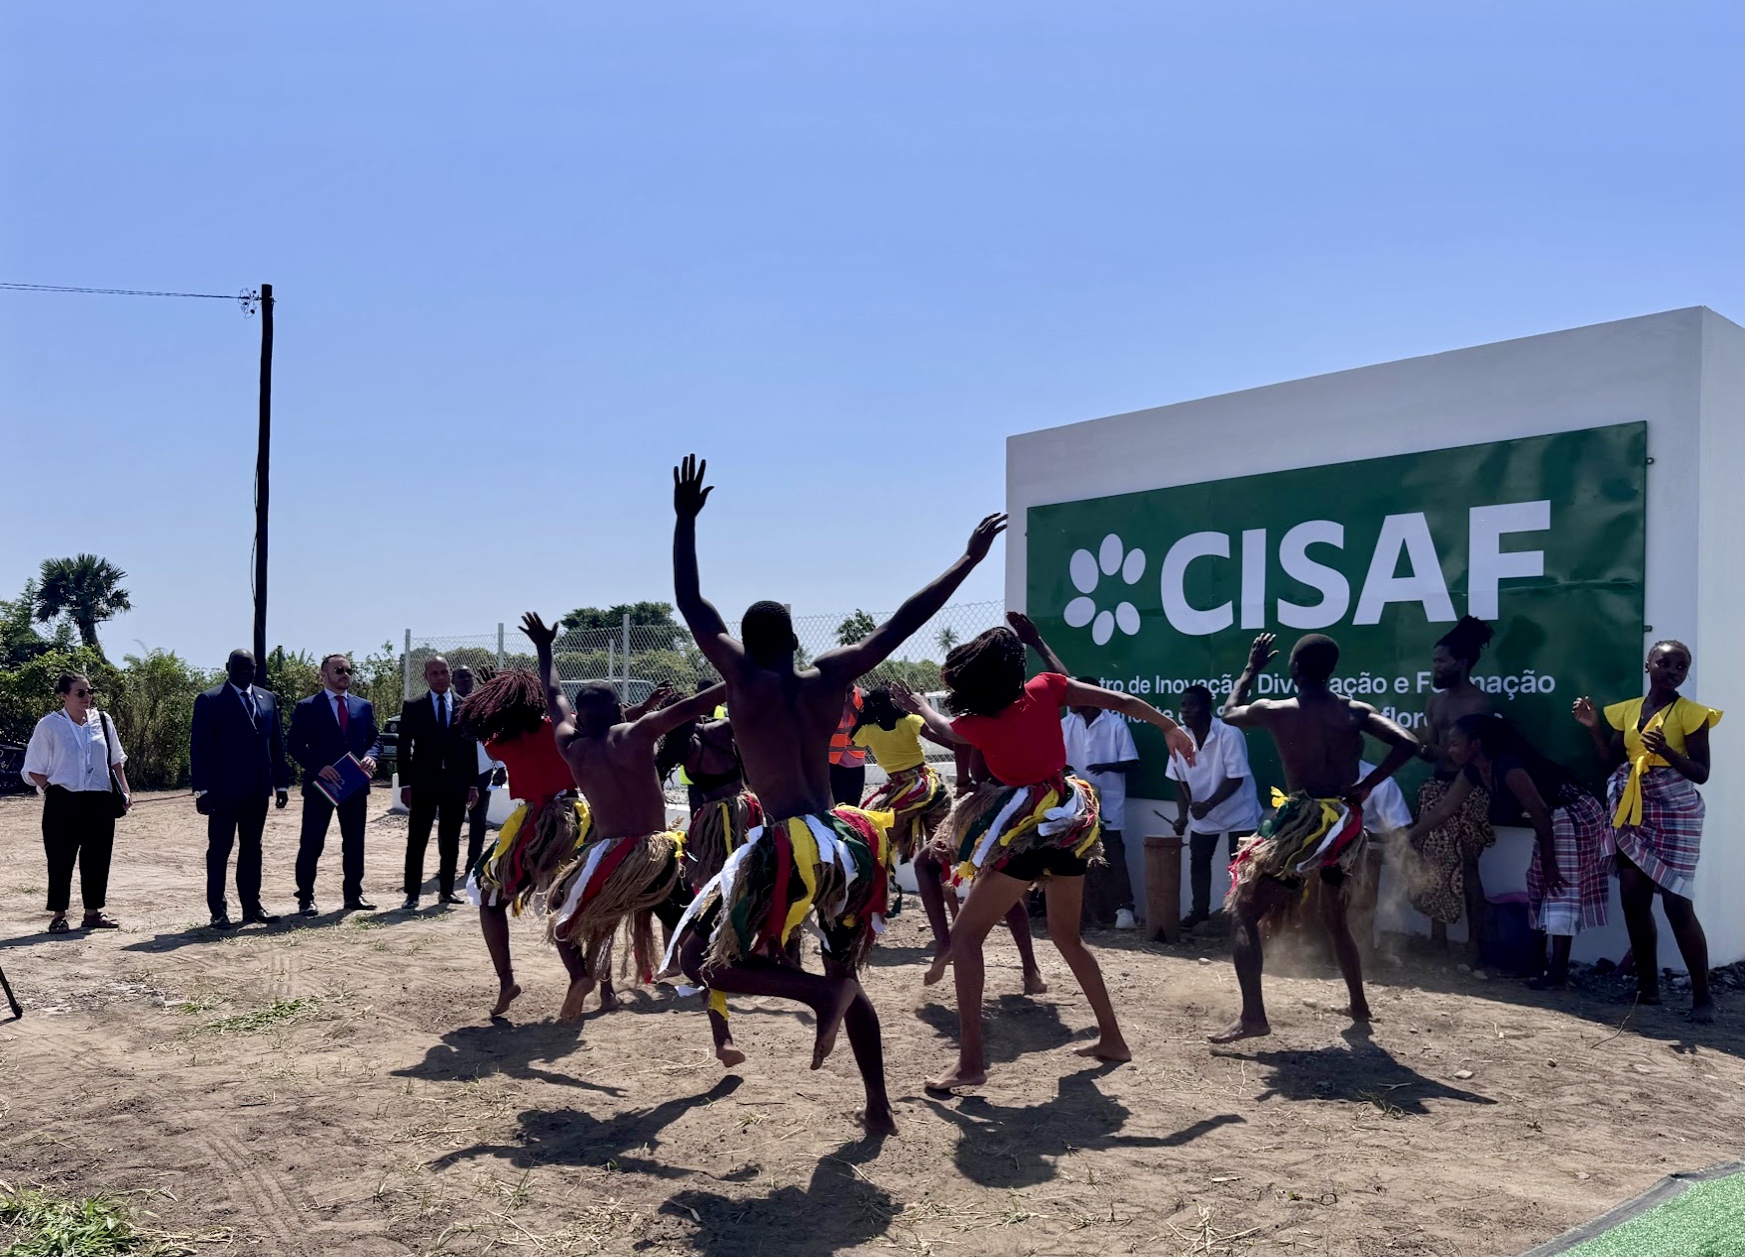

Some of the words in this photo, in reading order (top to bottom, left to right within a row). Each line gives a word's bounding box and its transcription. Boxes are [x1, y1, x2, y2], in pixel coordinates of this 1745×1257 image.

[1160, 499, 1551, 636] CISAF
[1128, 675, 1151, 694] de
[1155, 673, 1252, 700] Inovçã,
[1257, 671, 1388, 700] Divação
[1393, 676, 1410, 694] e
[1416, 669, 1556, 701] Fação
